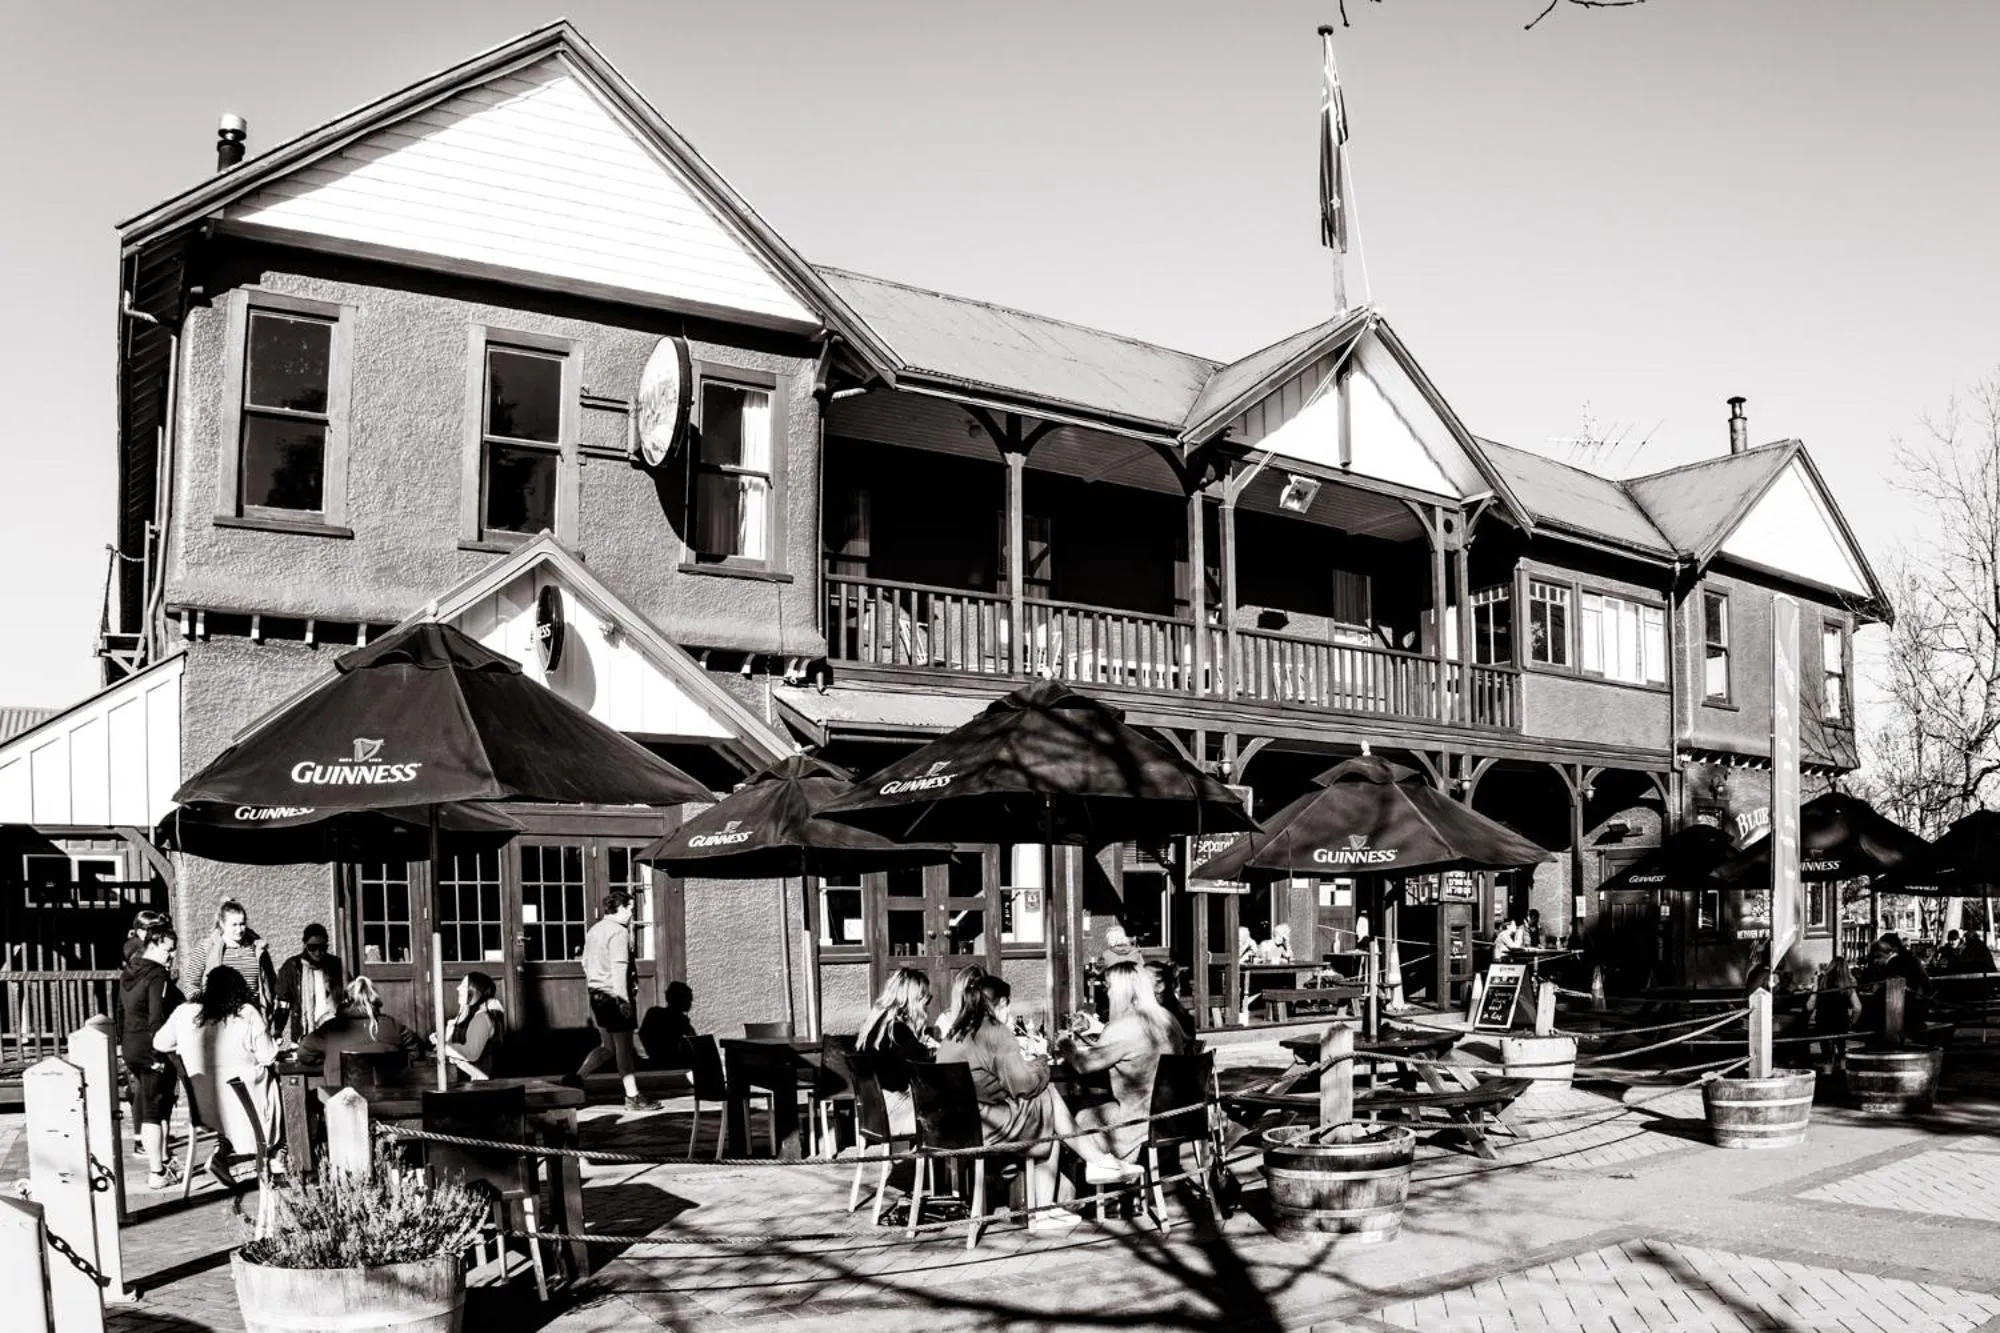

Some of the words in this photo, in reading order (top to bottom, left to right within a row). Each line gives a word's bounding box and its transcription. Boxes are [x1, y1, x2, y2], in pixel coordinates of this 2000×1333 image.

[291, 761, 419, 785] GUINNESS
[880, 775, 956, 795] GUINNESS
[688, 832, 753, 847] GUINNESS
[1313, 848, 1396, 864] GUINNESS
